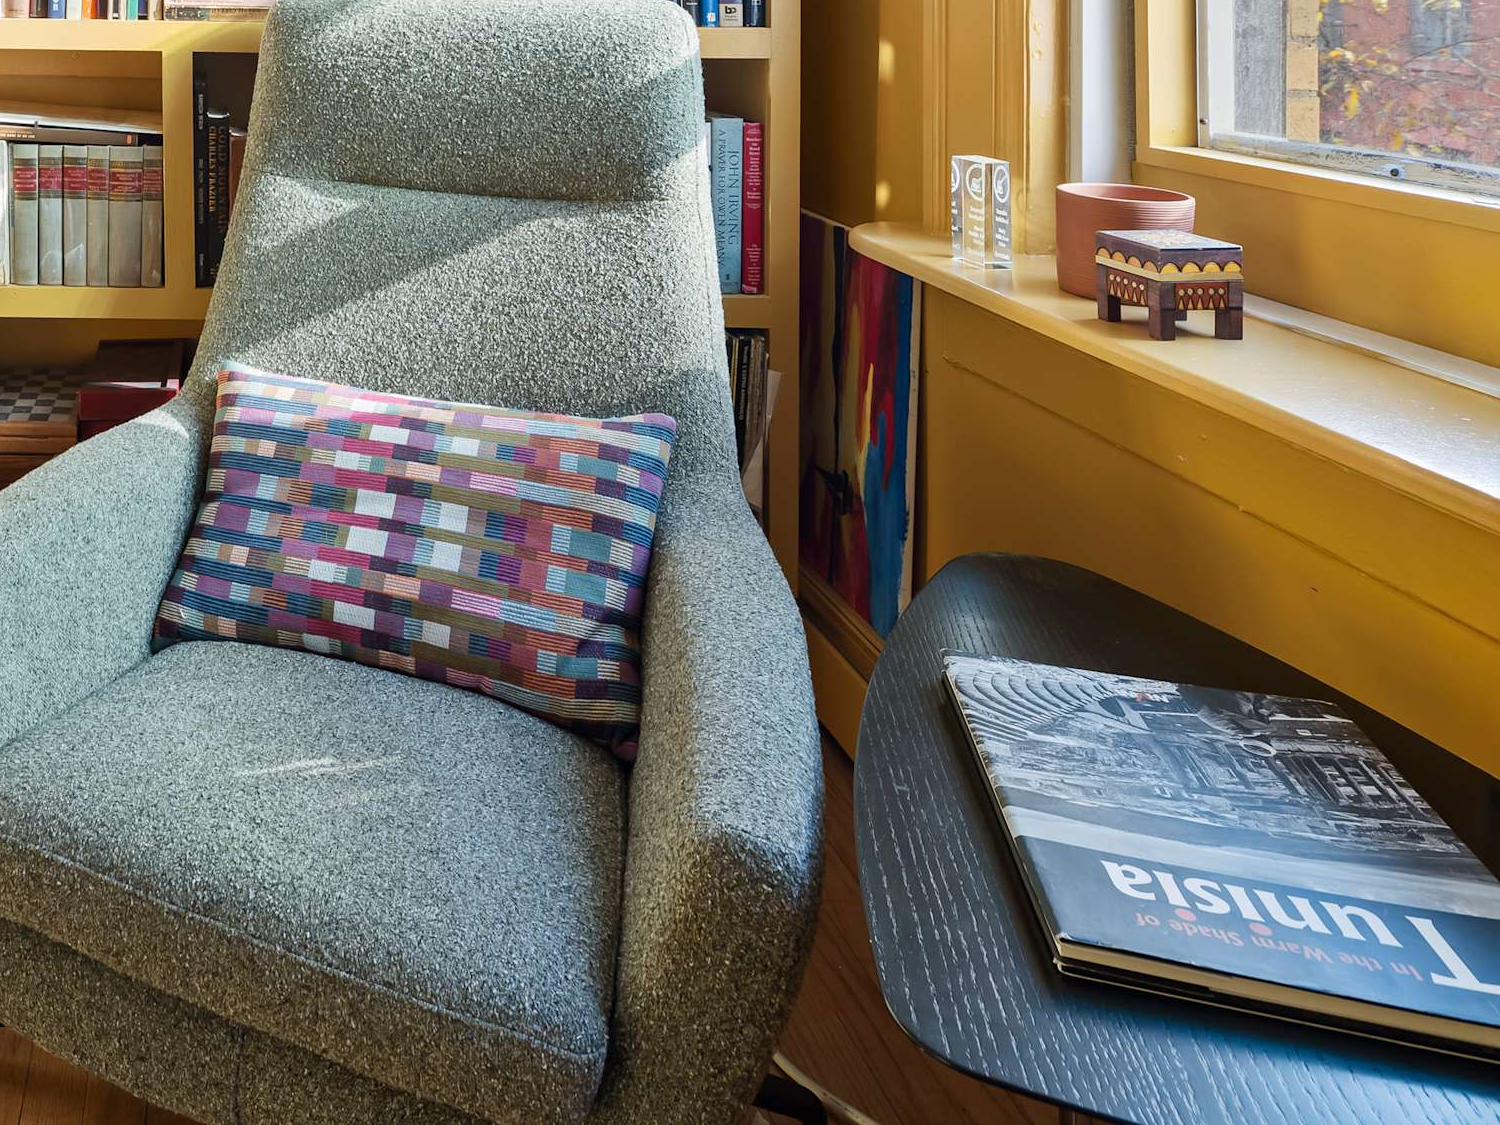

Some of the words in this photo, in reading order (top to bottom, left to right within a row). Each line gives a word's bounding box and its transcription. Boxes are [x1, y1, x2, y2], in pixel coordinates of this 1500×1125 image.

[727, 150, 739, 189] JOHN
[727, 194, 739, 245] IRVING
[1100, 859, 1500, 998] Tunisia
[1133, 907, 1162, 933] of
[1168, 915, 1246, 951] Shade
[1249, 929, 1332, 966] Warm
[1338, 949, 1384, 973] the
[1388, 959, 1424, 983] In
